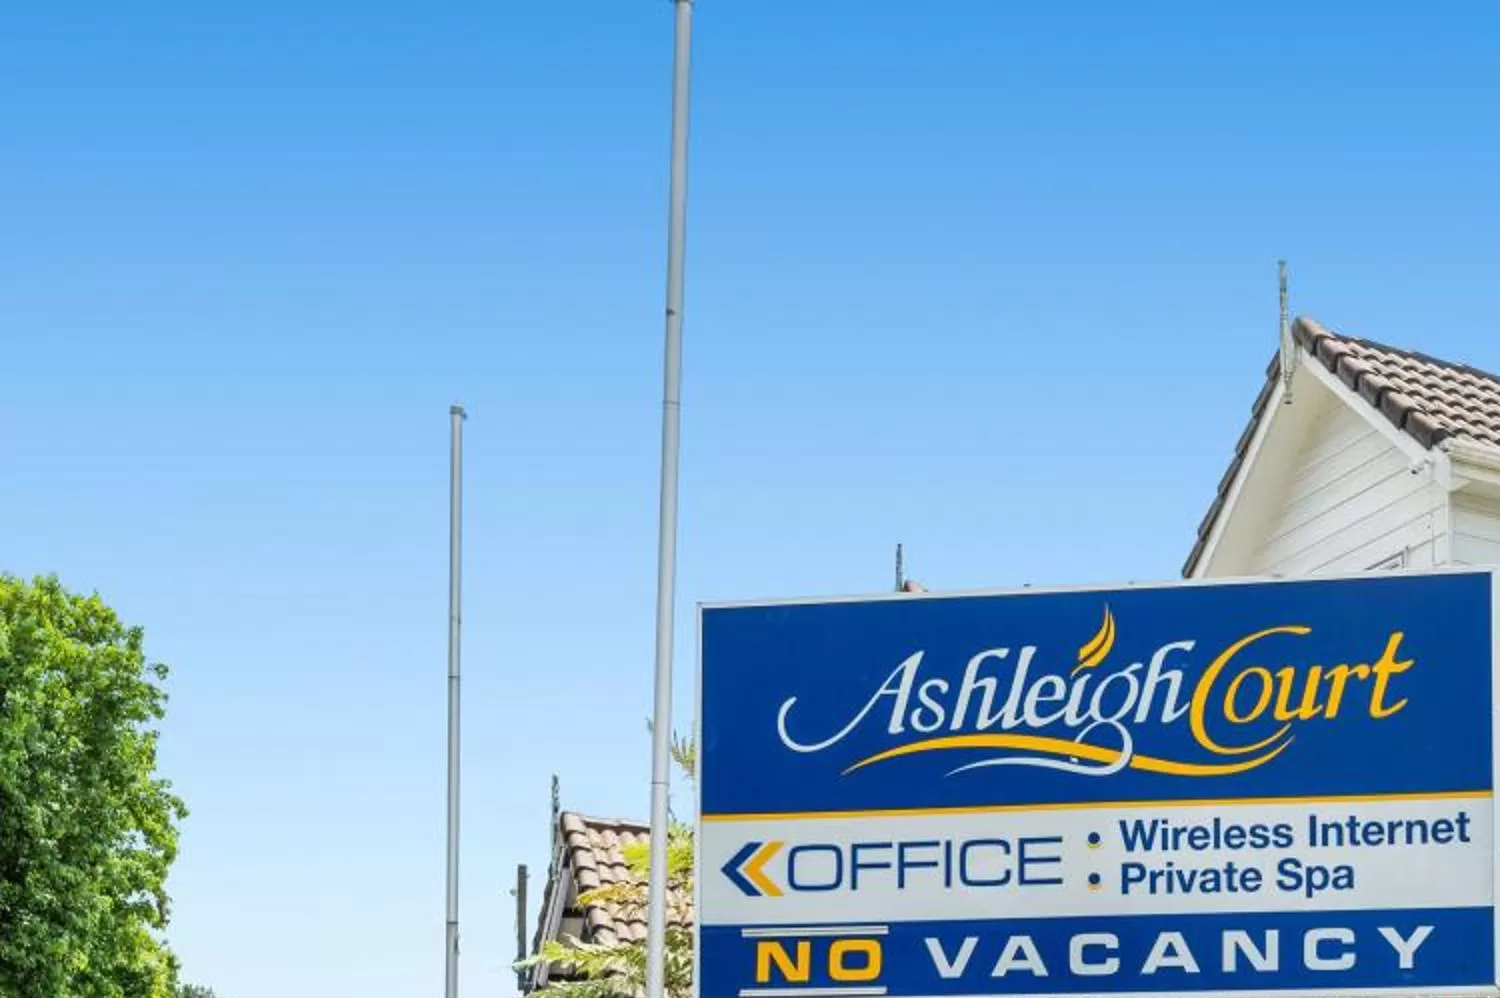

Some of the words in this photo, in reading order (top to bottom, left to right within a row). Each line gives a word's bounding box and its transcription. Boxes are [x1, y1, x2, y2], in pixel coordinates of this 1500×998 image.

[777, 640, 1195, 776] Ashleigh
[1190, 625, 1414, 755] Court
[1119, 818, 1294, 851] Wireless
[1309, 812, 1471, 847] Internet
[787, 836, 1064, 892] OFFICE
[1121, 861, 1262, 895] Private
[1276, 858, 1355, 898] Spa
[756, 939, 882, 982] NO
[925, 926, 1434, 978] VACANCY
